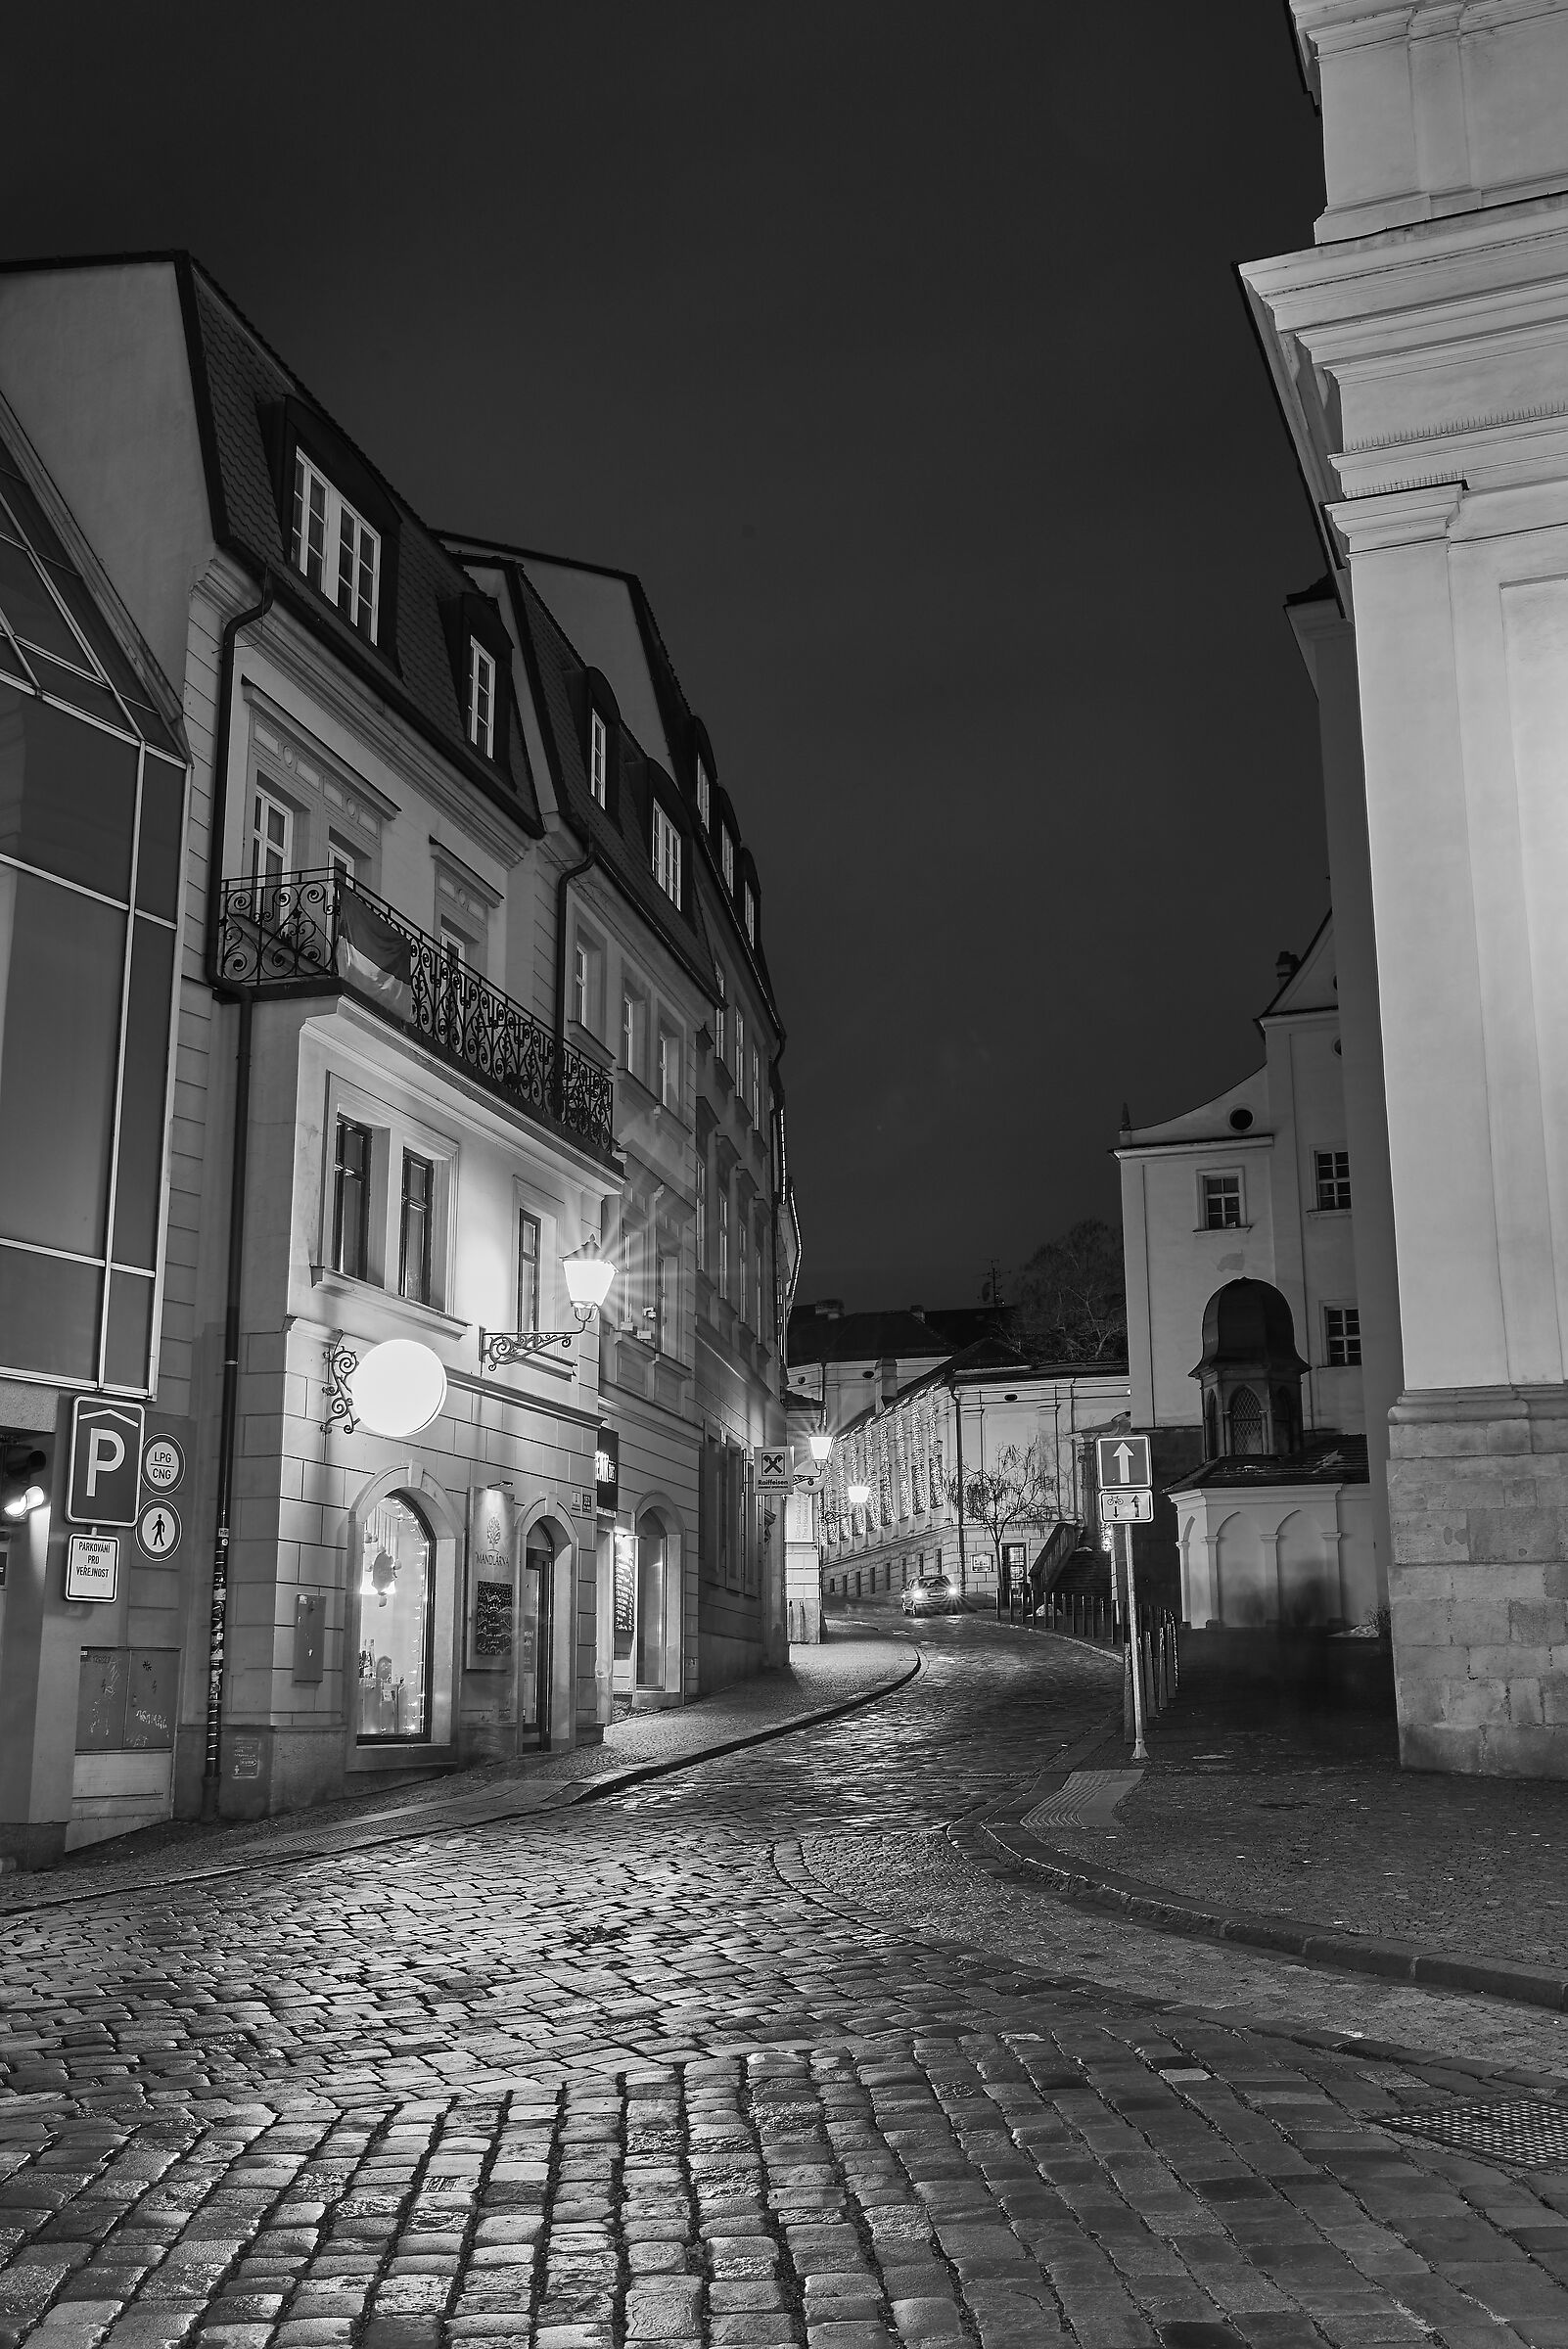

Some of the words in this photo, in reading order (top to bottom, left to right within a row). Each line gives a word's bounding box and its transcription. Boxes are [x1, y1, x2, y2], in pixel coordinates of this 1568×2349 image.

[86, 1427, 125, 1497] P
[154, 1451, 172, 1463] LPG
[153, 1468, 171, 1480] CNG
[78, 1542, 111, 1553] PARKOVÁNÍ
[87, 1555, 100, 1565] PRO
[76, 1564, 110, 1578] VEŘEJNOST
